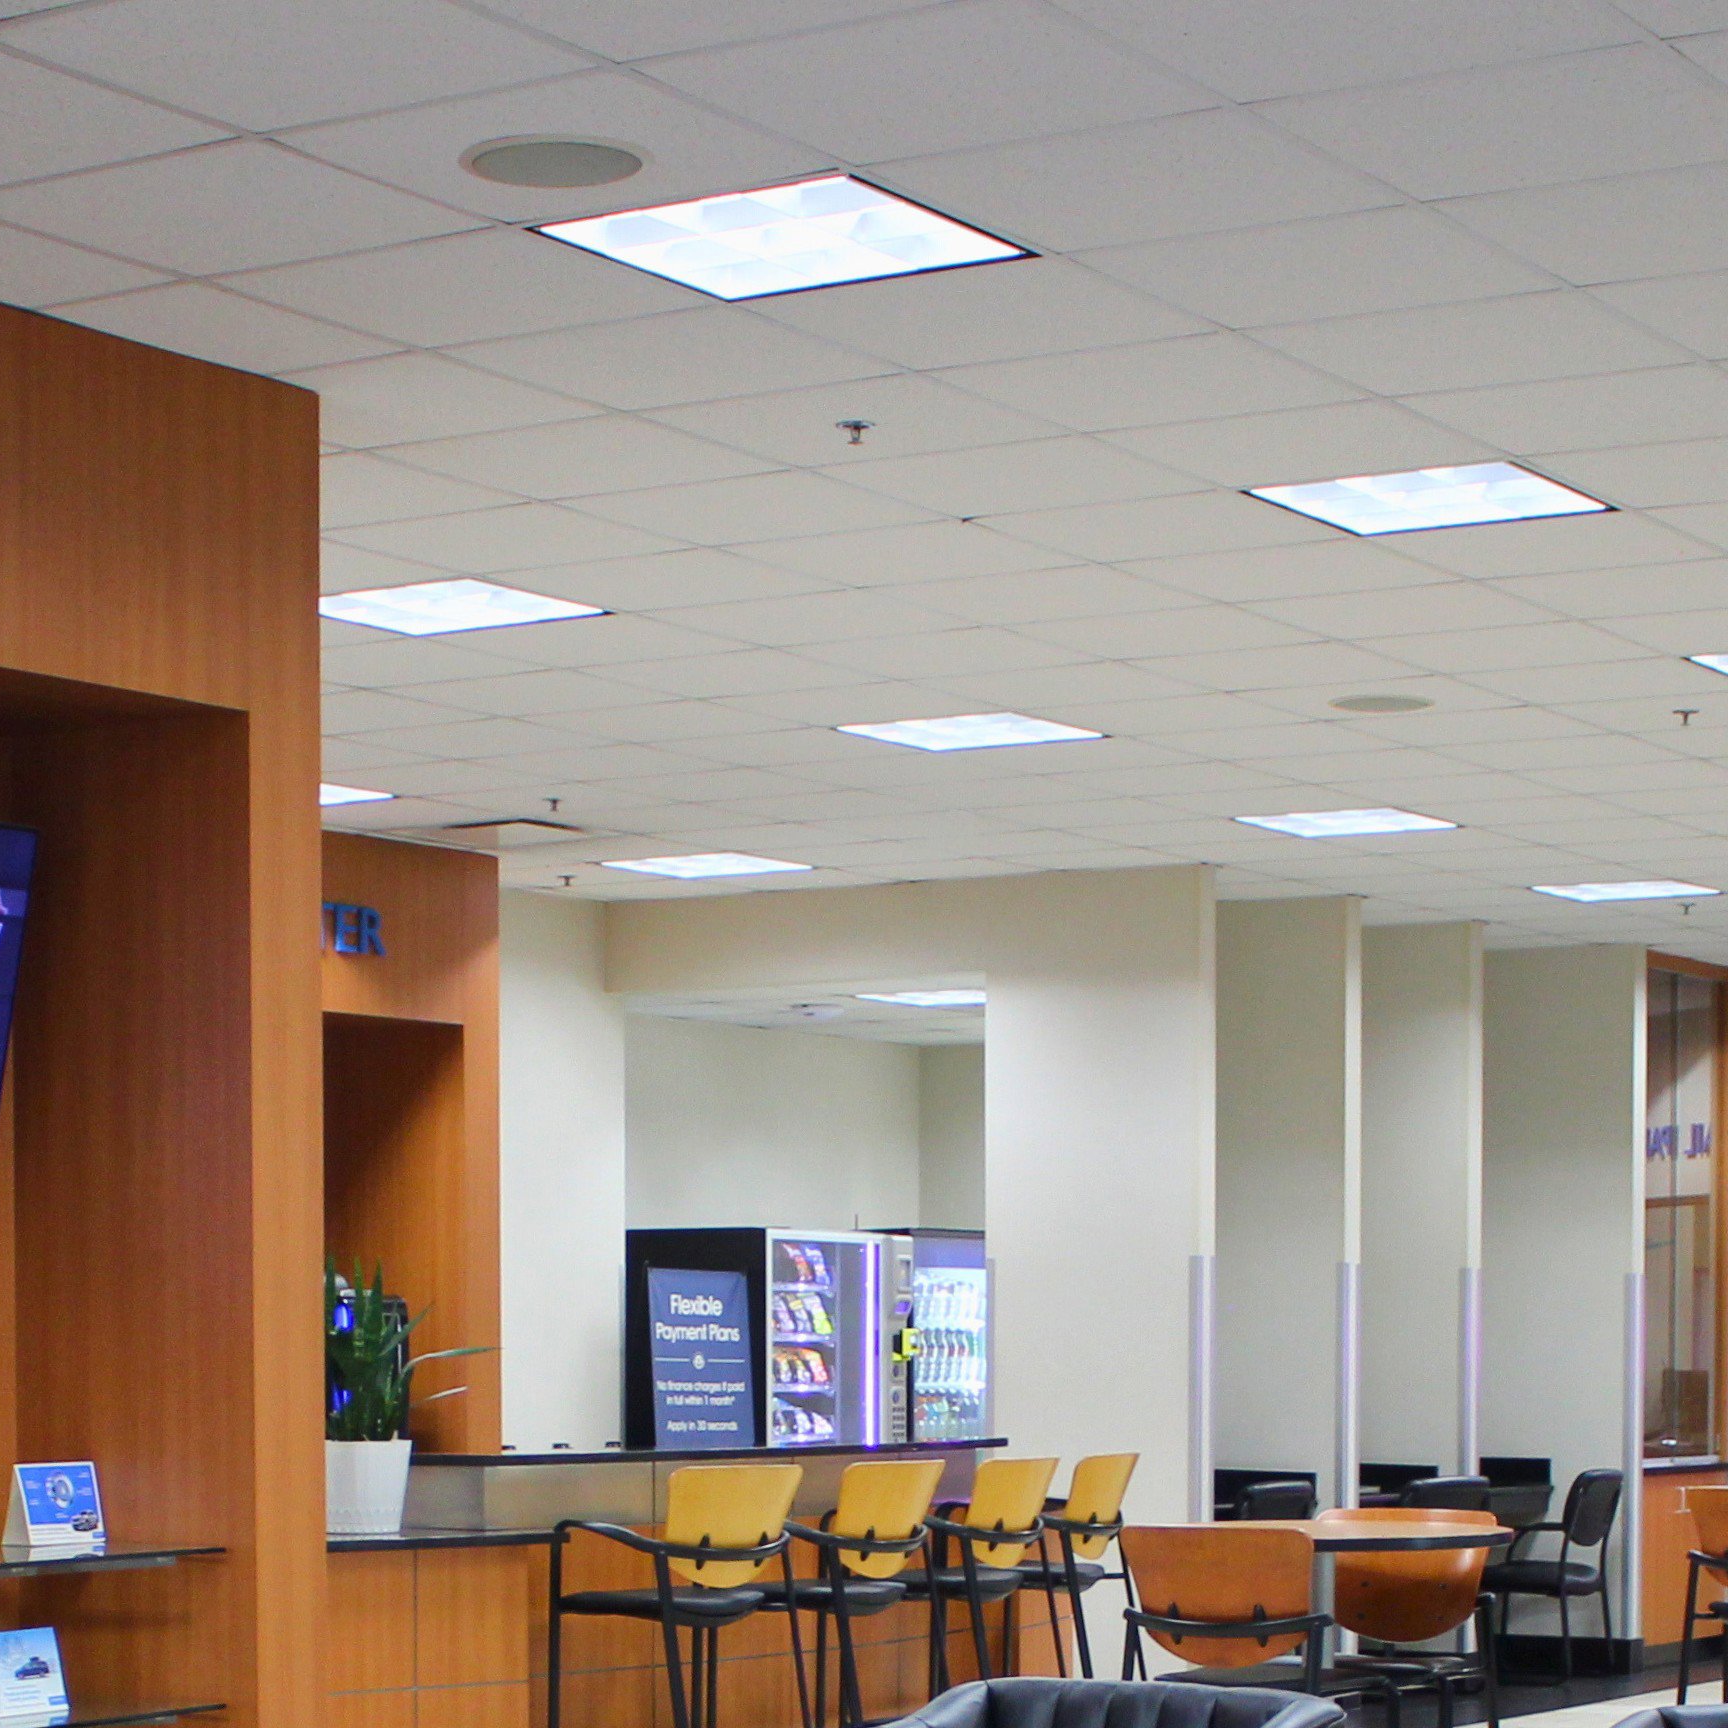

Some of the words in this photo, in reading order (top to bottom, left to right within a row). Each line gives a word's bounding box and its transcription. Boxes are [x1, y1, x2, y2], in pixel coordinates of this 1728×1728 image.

[669, 1293, 724, 1317] Flexible
[655, 1321, 708, 1344] Payment
[709, 1322, 741, 1342] Plans
[656, 1380, 667, 1391] No
[667, 1380, 693, 1391] finance
[693, 1382, 722, 1393] charges
[727, 1381, 746, 1393] paid
[674, 1395, 684, 1405] full
[684, 1395, 704, 1405] within
[667, 1420, 688, 1432] Apply
[707, 1421, 739, 1431] seconds
